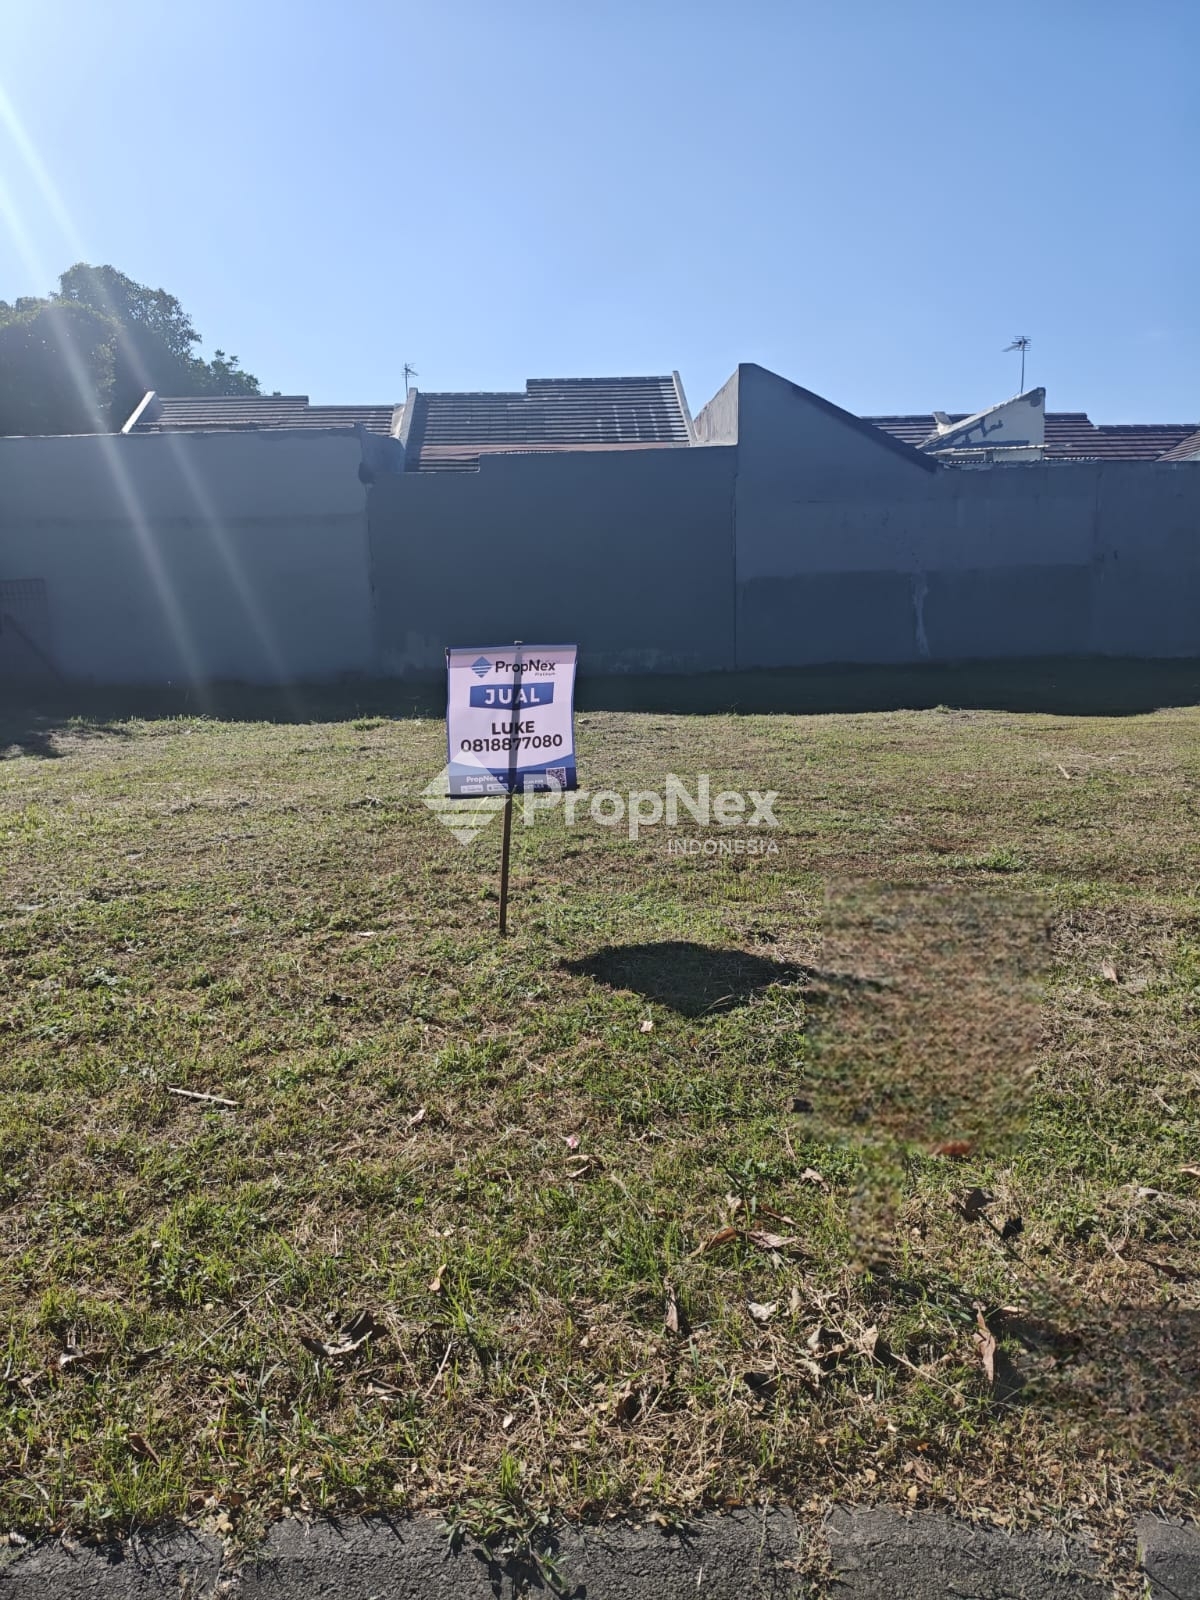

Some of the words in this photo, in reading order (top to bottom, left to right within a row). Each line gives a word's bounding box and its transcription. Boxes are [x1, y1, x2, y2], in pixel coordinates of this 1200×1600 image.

[495, 659, 556, 675] PropNex
[485, 688, 540, 704] JUAL
[491, 720, 535, 735] LUKE
[460, 734, 563, 753] 0818877080
[466, 775, 497, 783] PropNex
